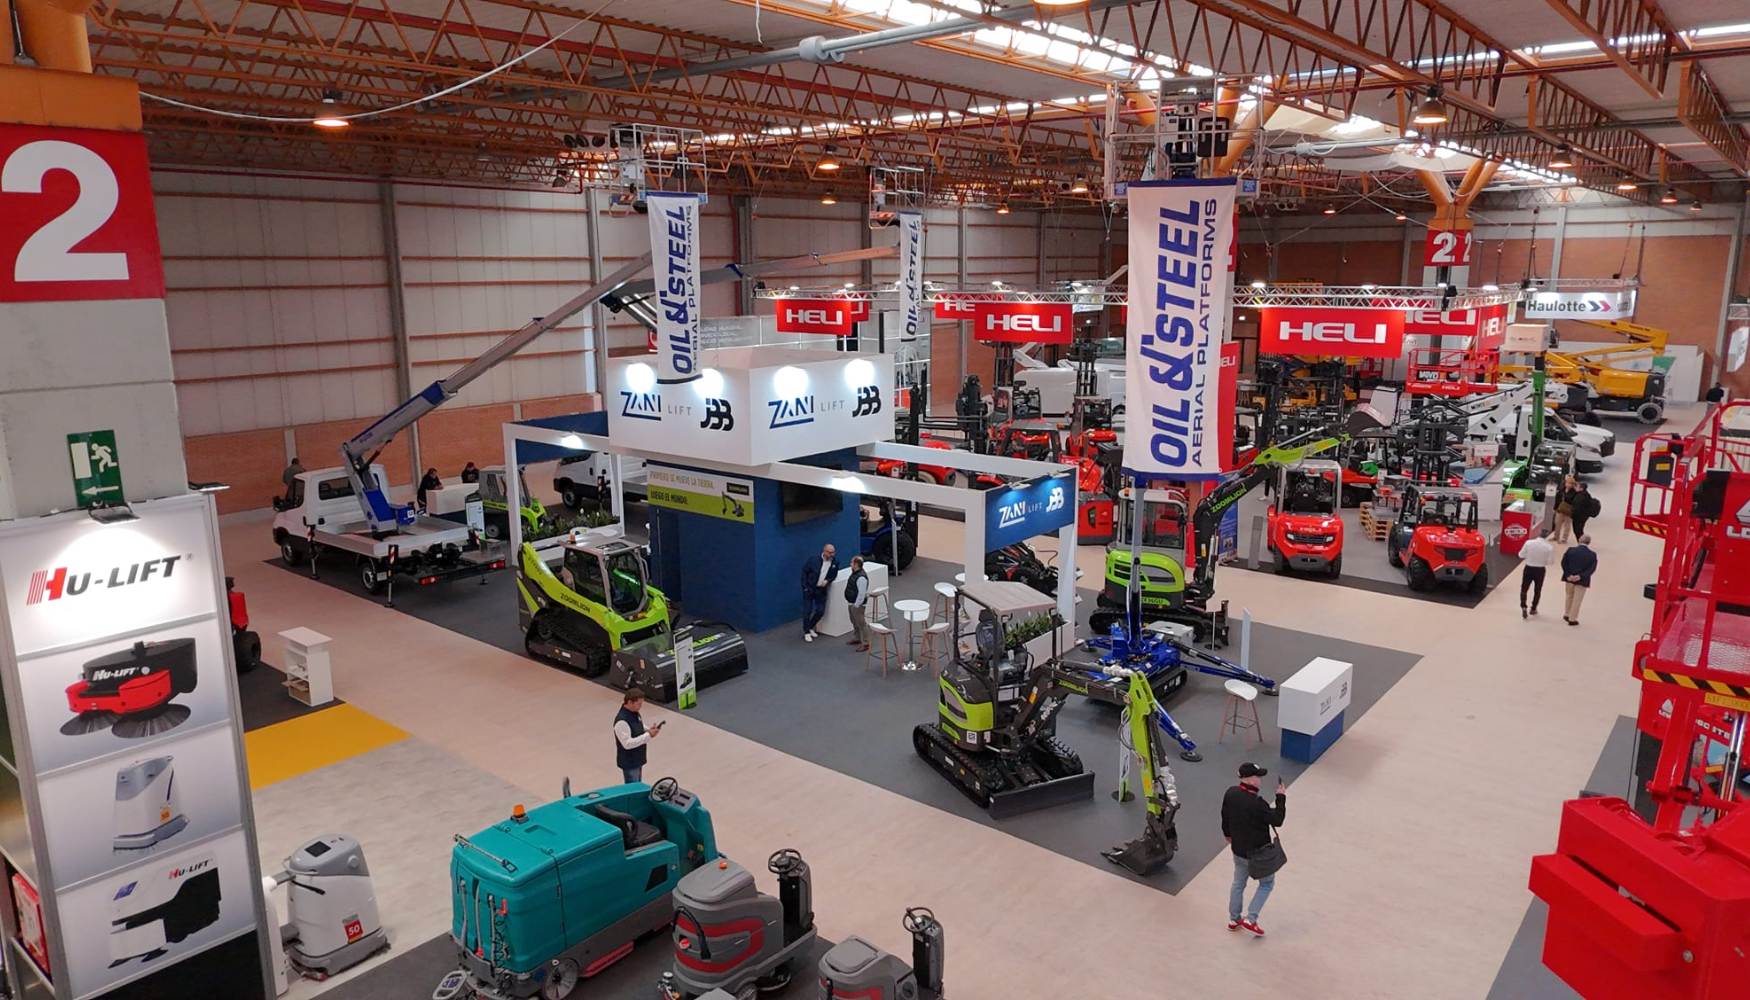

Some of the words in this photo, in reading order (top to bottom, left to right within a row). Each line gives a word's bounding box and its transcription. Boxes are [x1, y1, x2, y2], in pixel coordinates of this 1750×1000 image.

[1, 139, 130, 282] 2
[666, 205, 686, 297] STEEL
[686, 204, 697, 309] PLATFORMS
[1431, 232, 1457, 262] 2
[1463, 232, 1472, 262] 2
[1154, 199, 1200, 348] STEEL
[1196, 198, 1217, 367] PLATFORMS
[786, 308, 843, 325] HELI
[906, 305, 918, 336] OIL
[1406, 310, 1476, 326] ELI
[1527, 300, 1586, 312] Haulotte
[986, 314, 1062, 332] HELI
[1279, 321, 1387, 344] HELI
[669, 328, 692, 375] OIL
[1221, 355, 1236, 368] ELI
[620, 391, 662, 421] ZANI
[668, 404, 692, 416] LIFT
[768, 395, 814, 429] ZANI
[820, 400, 844, 412] LIFT
[1191, 373, 1207, 468] AERIAL
[1150, 397, 1191, 468] OIL
[998, 500, 1026, 528] ZANI
[1028, 502, 1042, 513] LIFT
[1211, 488, 1247, 512] ZOOMLION
[560, 592, 590, 612] ZOOMLION
[348, 924, 360, 936] 50
